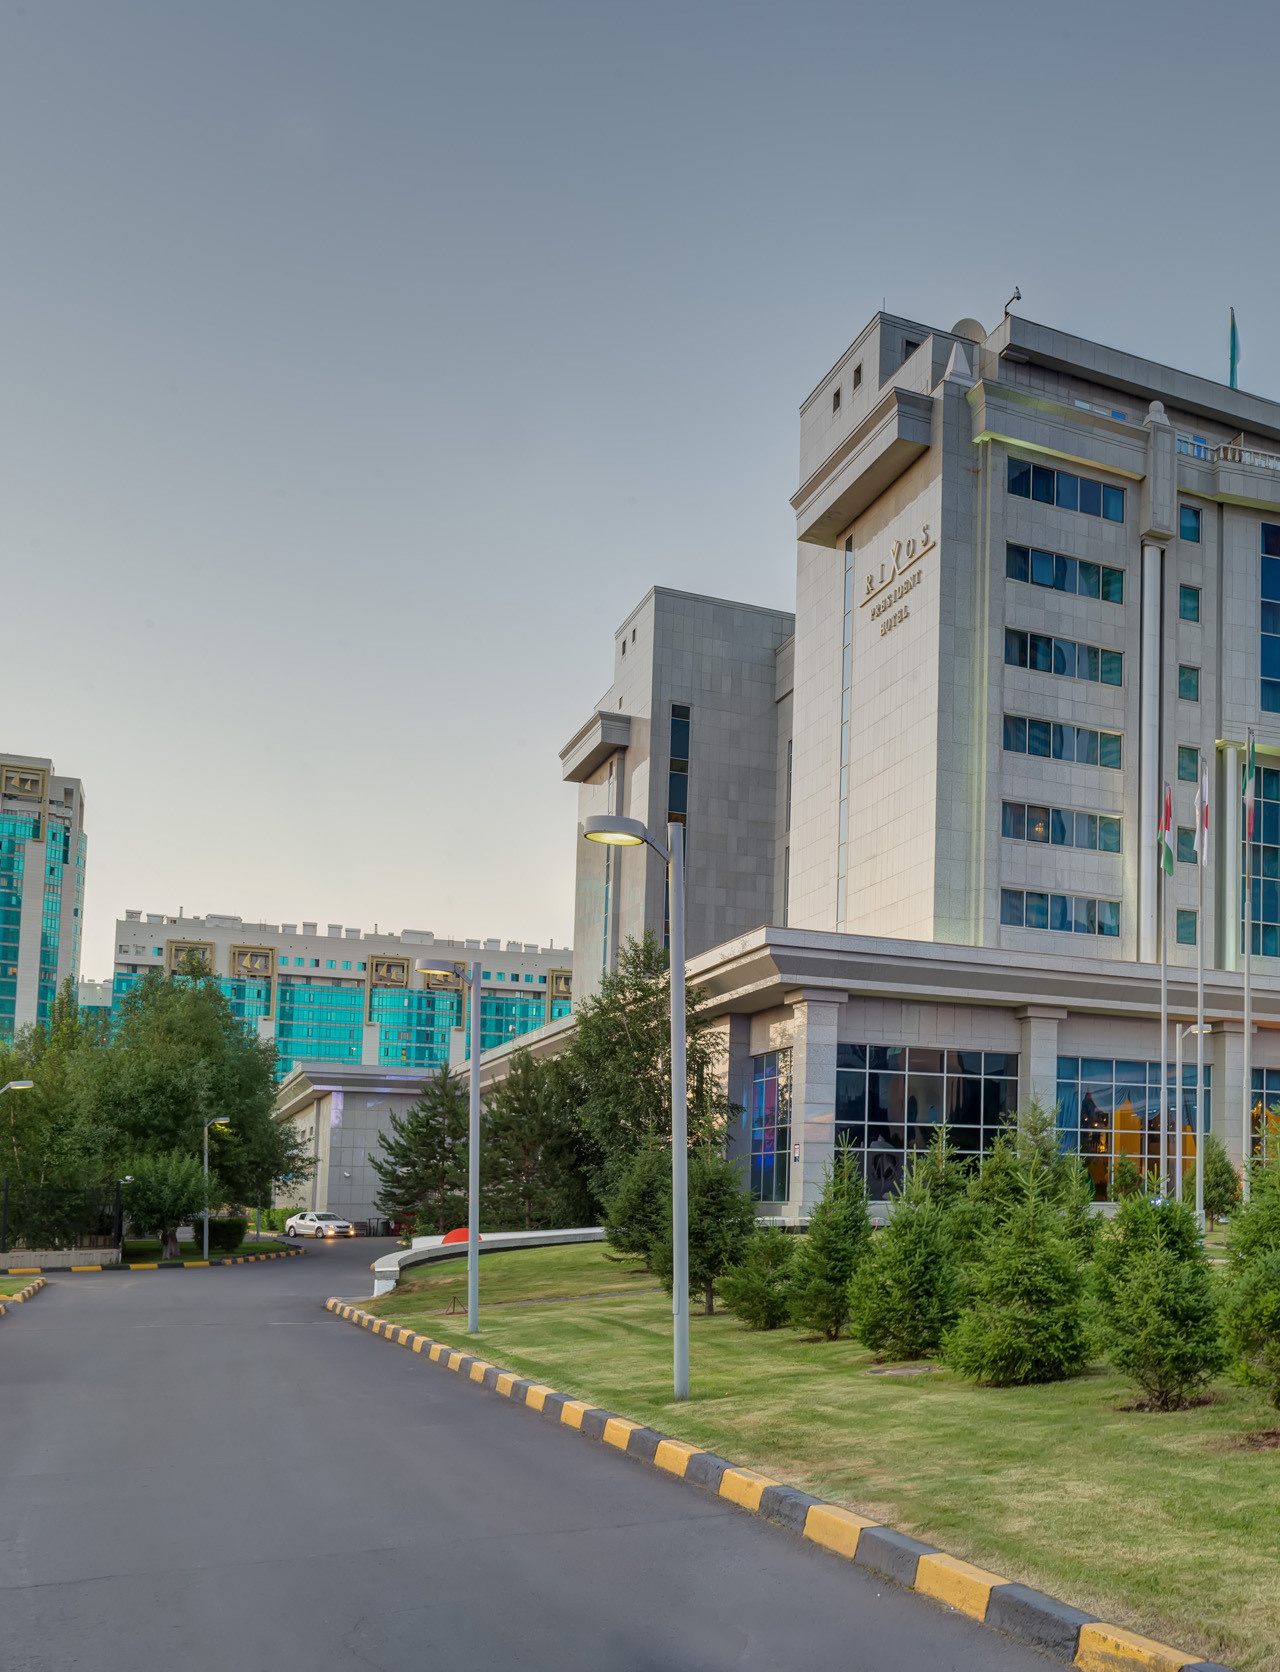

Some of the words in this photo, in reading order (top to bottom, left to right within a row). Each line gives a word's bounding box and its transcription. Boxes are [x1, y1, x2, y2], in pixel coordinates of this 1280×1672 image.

[864, 524, 931, 598] RIXOS
[870, 570, 922, 621] PRESIDENT
[880, 605, 910, 637] HOTEL
